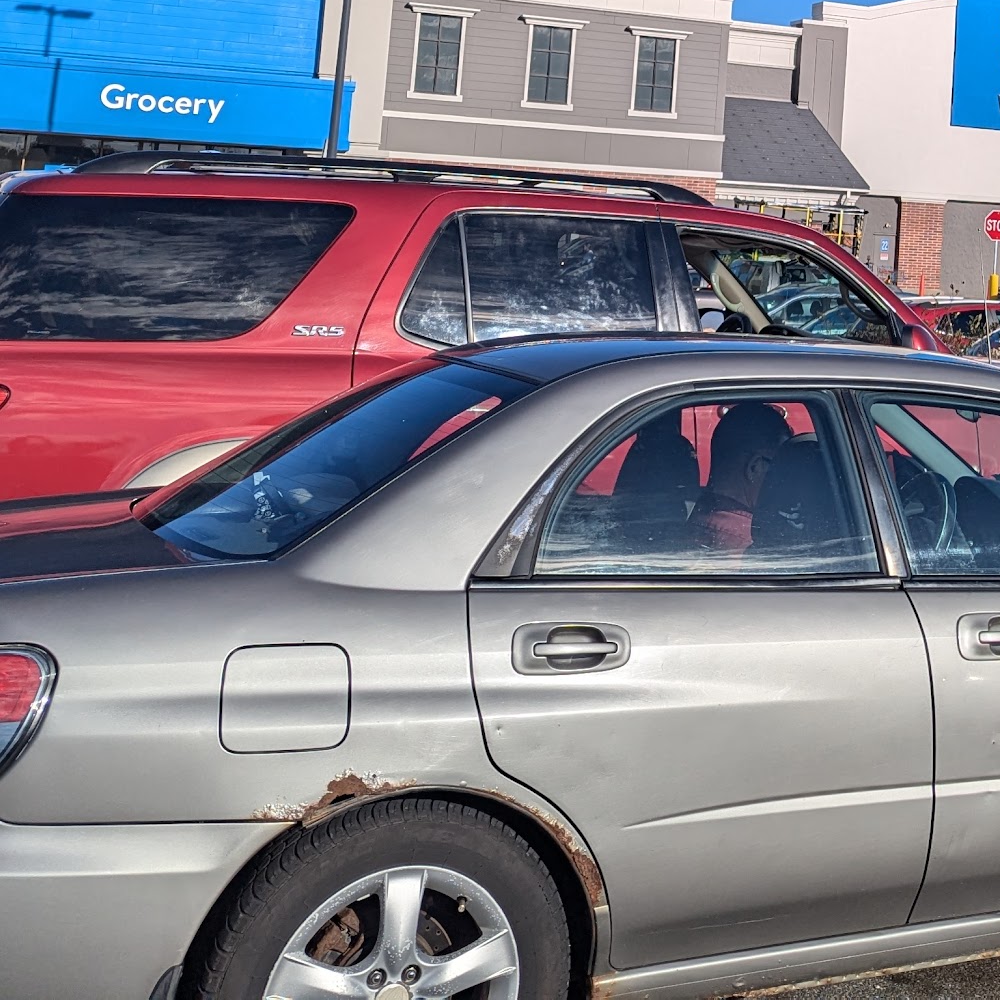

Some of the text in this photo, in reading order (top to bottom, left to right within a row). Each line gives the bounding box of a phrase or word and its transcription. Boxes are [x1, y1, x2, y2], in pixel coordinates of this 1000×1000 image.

[100, 83, 225, 124] Grocery
[881, 240, 889, 251] 22
[291, 325, 345, 337] SR5
